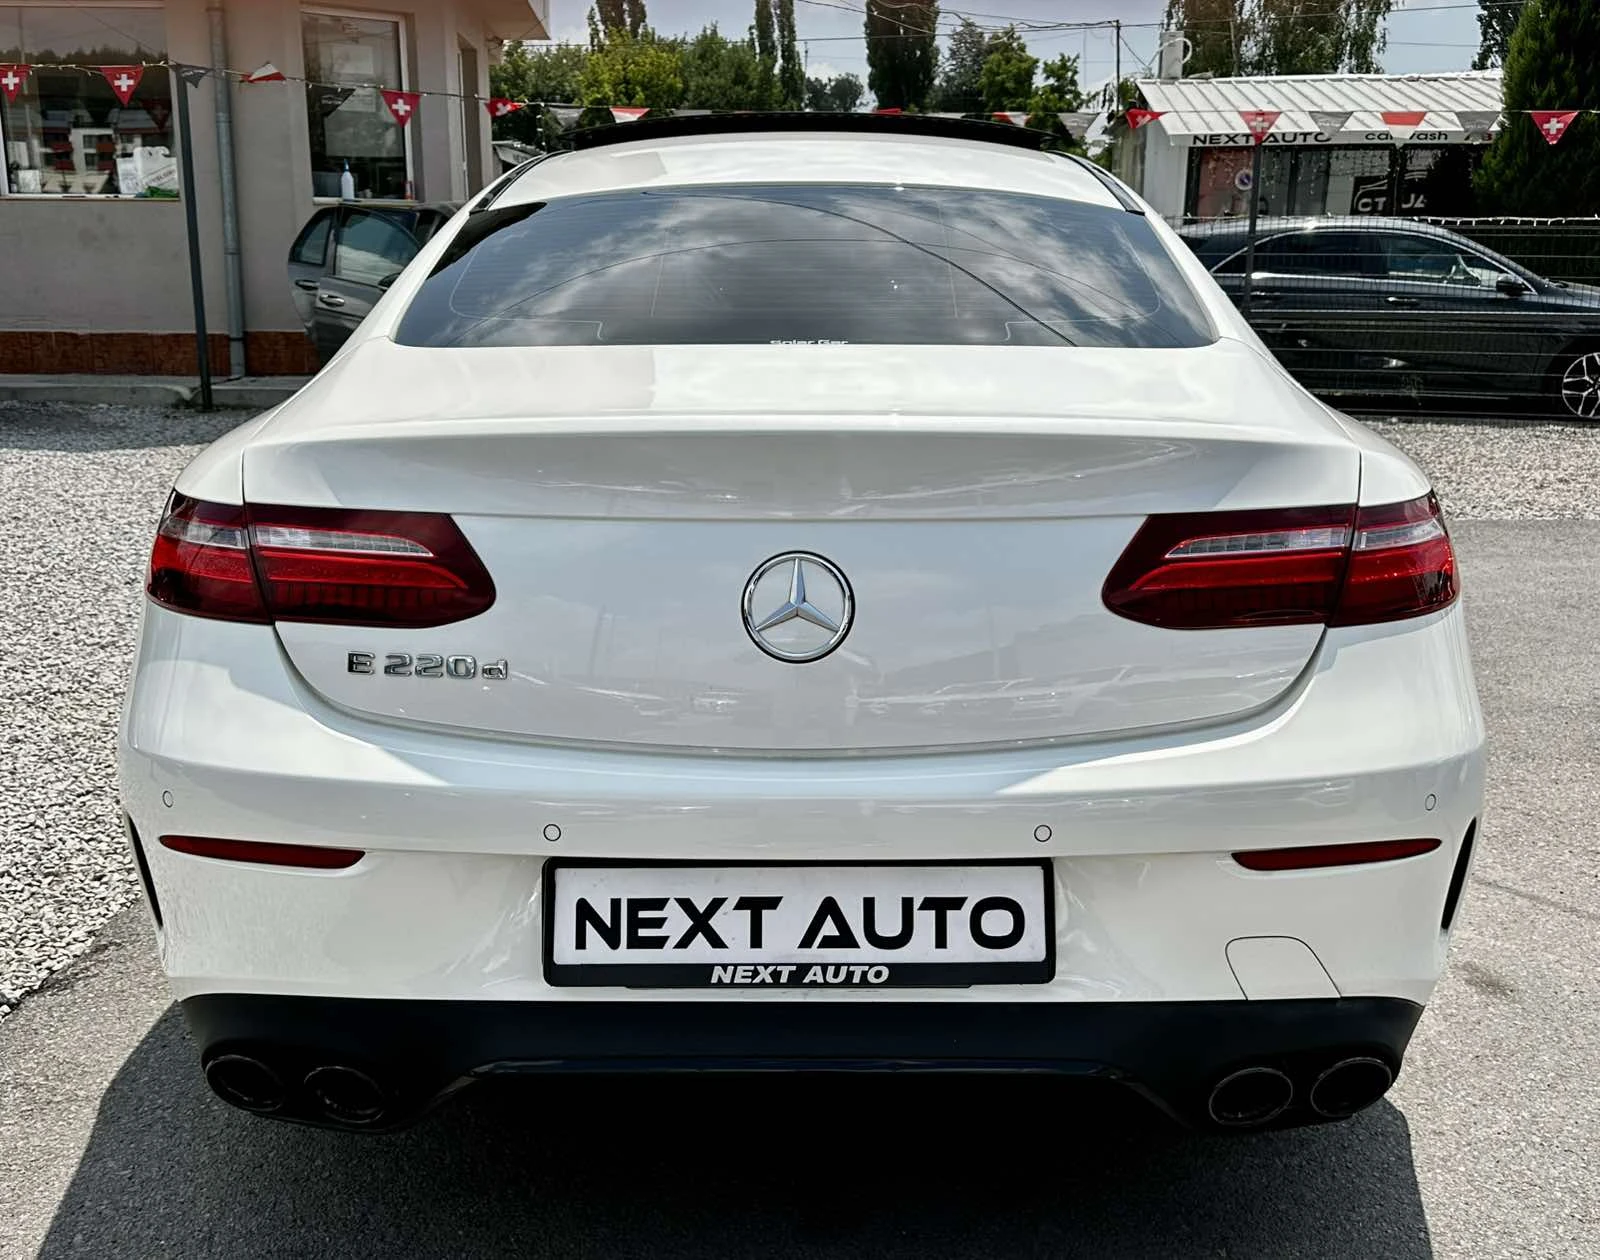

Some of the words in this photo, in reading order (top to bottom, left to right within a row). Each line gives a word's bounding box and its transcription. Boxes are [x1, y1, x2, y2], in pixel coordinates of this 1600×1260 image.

[1192, 132, 1254, 145] NEXT
[347, 651, 376, 676] E
[383, 652, 508, 680] 220d
[574, 895, 784, 951] NEXT
[797, 895, 1027, 951] AUTO
[710, 965, 798, 985] NEXT
[802, 965, 891, 984] AUTO
